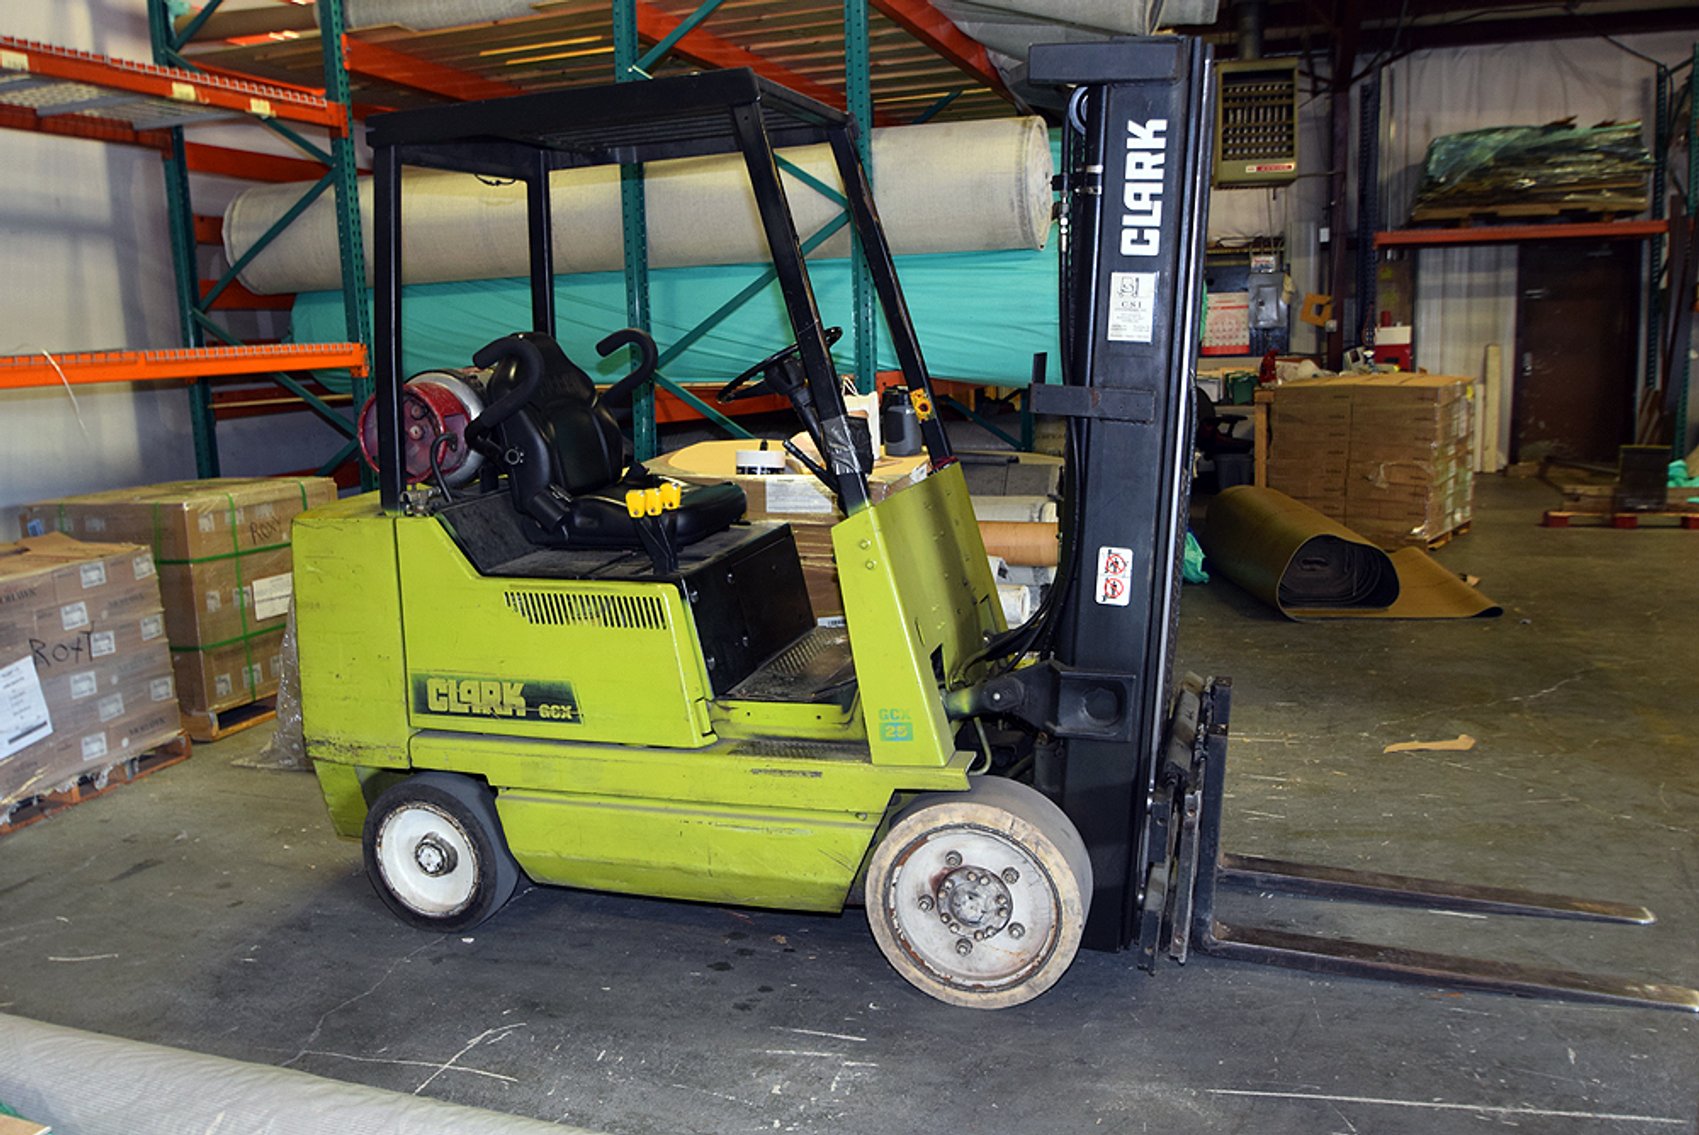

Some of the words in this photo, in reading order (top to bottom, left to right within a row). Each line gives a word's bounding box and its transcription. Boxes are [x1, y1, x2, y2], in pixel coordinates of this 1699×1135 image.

[1120, 118, 1168, 256] CLARK
[426, 677, 526, 717] CLARK
[885, 725, 908, 738] 25
